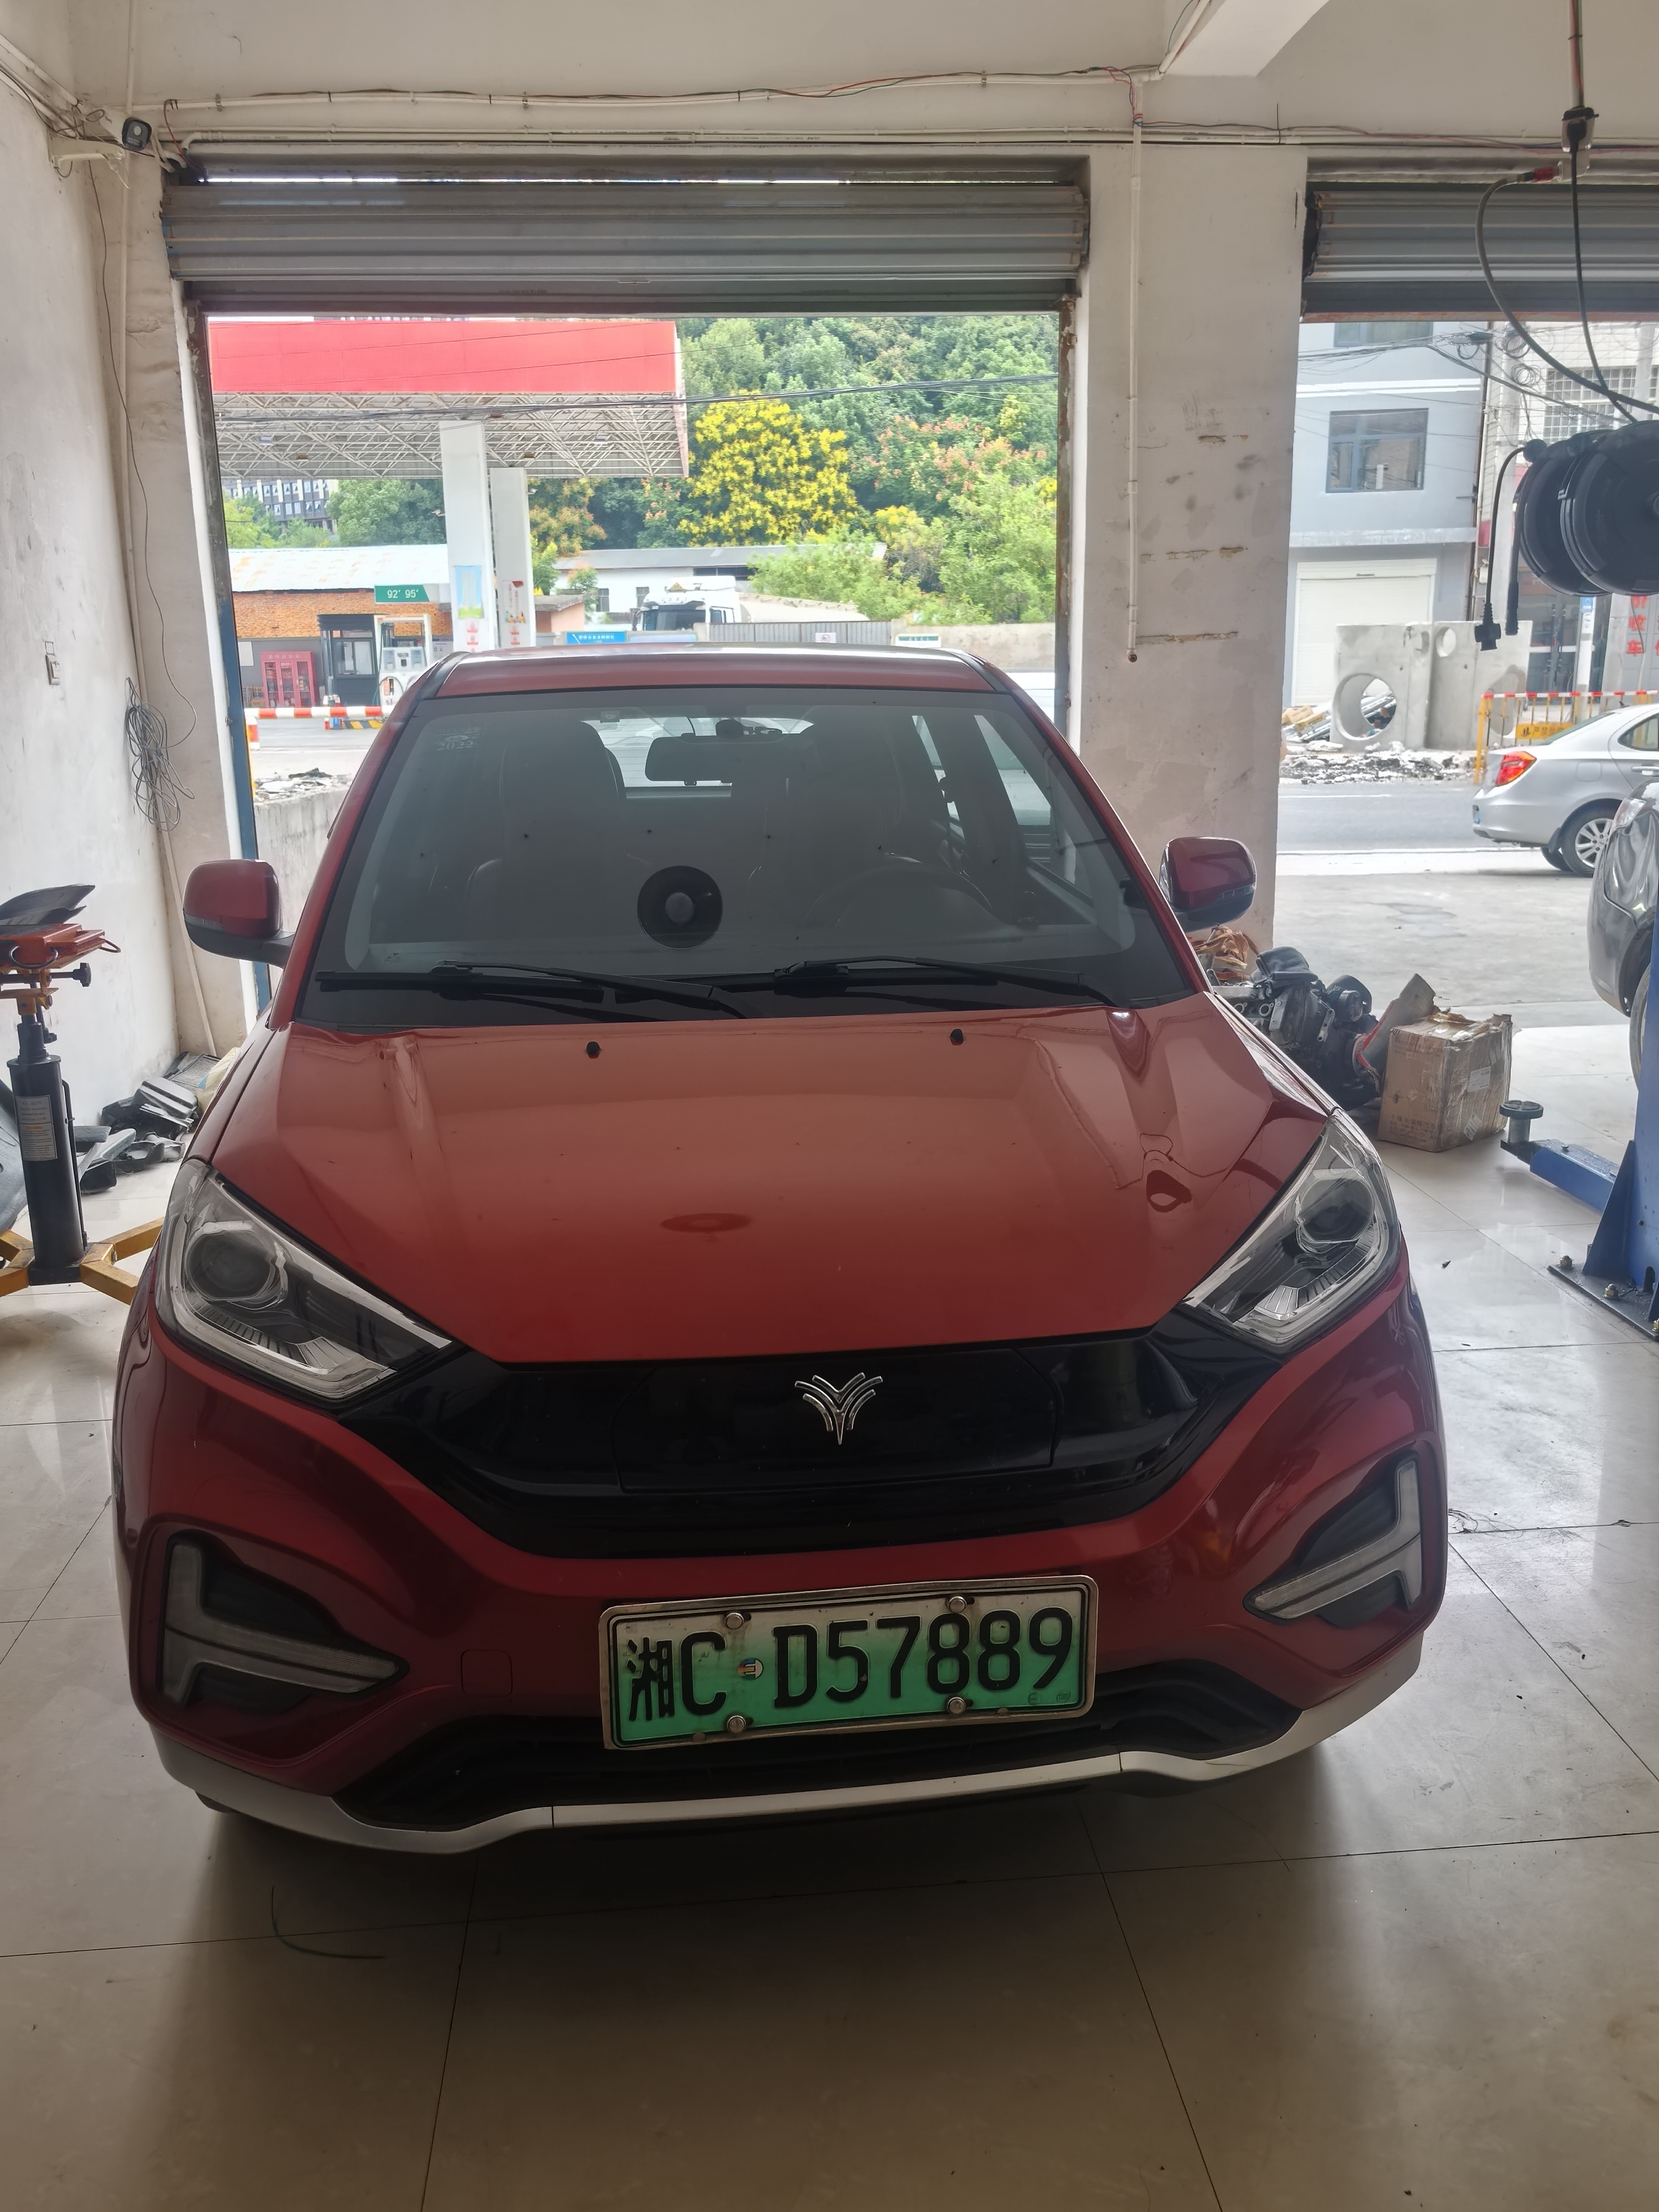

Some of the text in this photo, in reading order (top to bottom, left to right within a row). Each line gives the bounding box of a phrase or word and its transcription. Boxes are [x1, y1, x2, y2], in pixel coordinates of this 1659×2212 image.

[436, 740, 474, 751] 2022
[627, 1607, 1075, 1721] 湘C D57889
